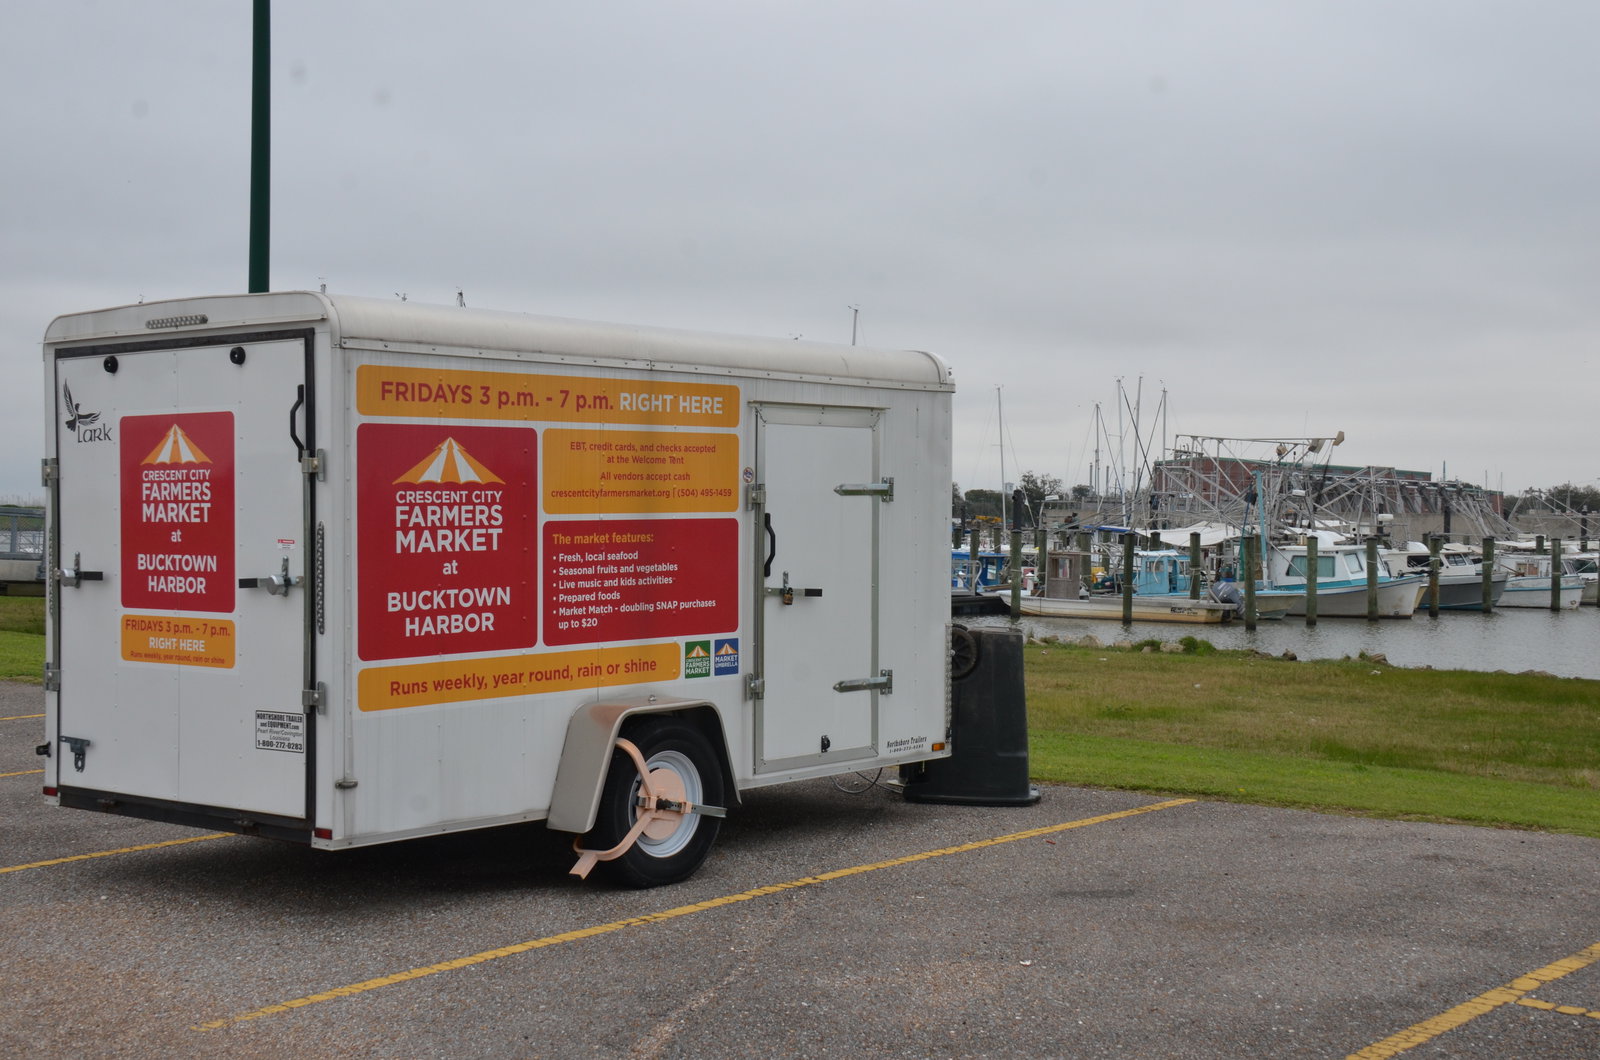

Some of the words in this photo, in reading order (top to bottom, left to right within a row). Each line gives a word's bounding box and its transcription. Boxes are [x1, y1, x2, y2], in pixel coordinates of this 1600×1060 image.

[380, 381, 473, 404] FRIDAYS
[480, 385, 490, 405] 3
[498, 389, 539, 410] p.m.
[560, 390, 569, 407] 7
[576, 393, 613, 413] p.m.
[620, 393, 674, 413] RIGHT
[679, 395, 723, 415] HERE
[571, 442, 587, 451] EBT,
[589, 443, 612, 451] credit
[615, 443, 638, 452] cards,
[640, 444, 654, 452] and
[656, 444, 682, 453] checks
[684, 445, 716, 453] accepted
[632, 456, 666, 464] Welcome
[670, 456, 684, 464] Tent
[143, 470, 187, 481] CRESCENT
[190, 469, 211, 480] CITY
[601, 472, 611, 480] All
[614, 472, 644, 480] vendors
[646, 473, 671, 482] accept
[674, 472, 690, 480] cash
[142, 482, 211, 500] FARMERS
[396, 491, 468, 504] CRESCENT
[472, 491, 503, 503] CITY
[551, 488, 670, 498] crescentcityfarmersmarket.org
[677, 489, 698, 497] (504)
[700, 489, 732, 497] 495-1459
[142, 503, 211, 522] MARKET
[396, 505, 503, 527] FARMERS
[171, 529, 182, 542] at
[396, 529, 503, 553] MARKET
[553, 534, 571, 545] The
[574, 533, 609, 544] market
[612, 533, 653, 543] features:
[138, 554, 217, 572] BUCKTOWN
[559, 553, 583, 563] Fresh,
[586, 552, 605, 561] local
[608, 551, 638, 560] seafood
[443, 560, 458, 575] at
[559, 566, 595, 576] Seasonal
[597, 565, 618, 574] fruits
[620, 564, 634, 573] and
[636, 563, 678, 573] vegetables
[148, 576, 206, 594] HARBOR
[559, 580, 576, 589] Live
[578, 579, 601, 588] music
[604, 578, 618, 587] and
[620, 577, 636, 586] kids
[638, 576, 673, 585] activities
[388, 587, 510, 612] BUCKTOWN
[559, 593, 596, 603] Prepared
[598, 591, 620, 600] foods
[559, 606, 586, 616] Market
[589, 605, 613, 615] Match
[620, 602, 654, 613] doubling
[656, 601, 677, 610] SNAP
[680, 600, 716, 610] purchases
[126, 619, 163, 632] FRIDAYS
[166, 622, 171, 632] 3
[174, 623, 193, 635] p.m.
[203, 624, 207, 634] 7
[211, 625, 230, 637] p.m.
[406, 613, 494, 637] HARBOR
[559, 620, 569, 629] up
[571, 619, 579, 628] to
[582, 618, 598, 627] $20
[149, 637, 177, 649] RIGHT
[180, 639, 205, 652] HERE
[163, 654, 173, 662] year
[390, 681, 428, 696] Runs
[433, 673, 488, 692] weekly,
[493, 671, 524, 688] year
[529, 665, 573, 682] round,
[578, 663, 602, 678] rain
[606, 662, 620, 675] or
[624, 659, 657, 673] shine
[686, 667, 709, 675] MARKET
[286, 715, 302, 723] TRAILER
